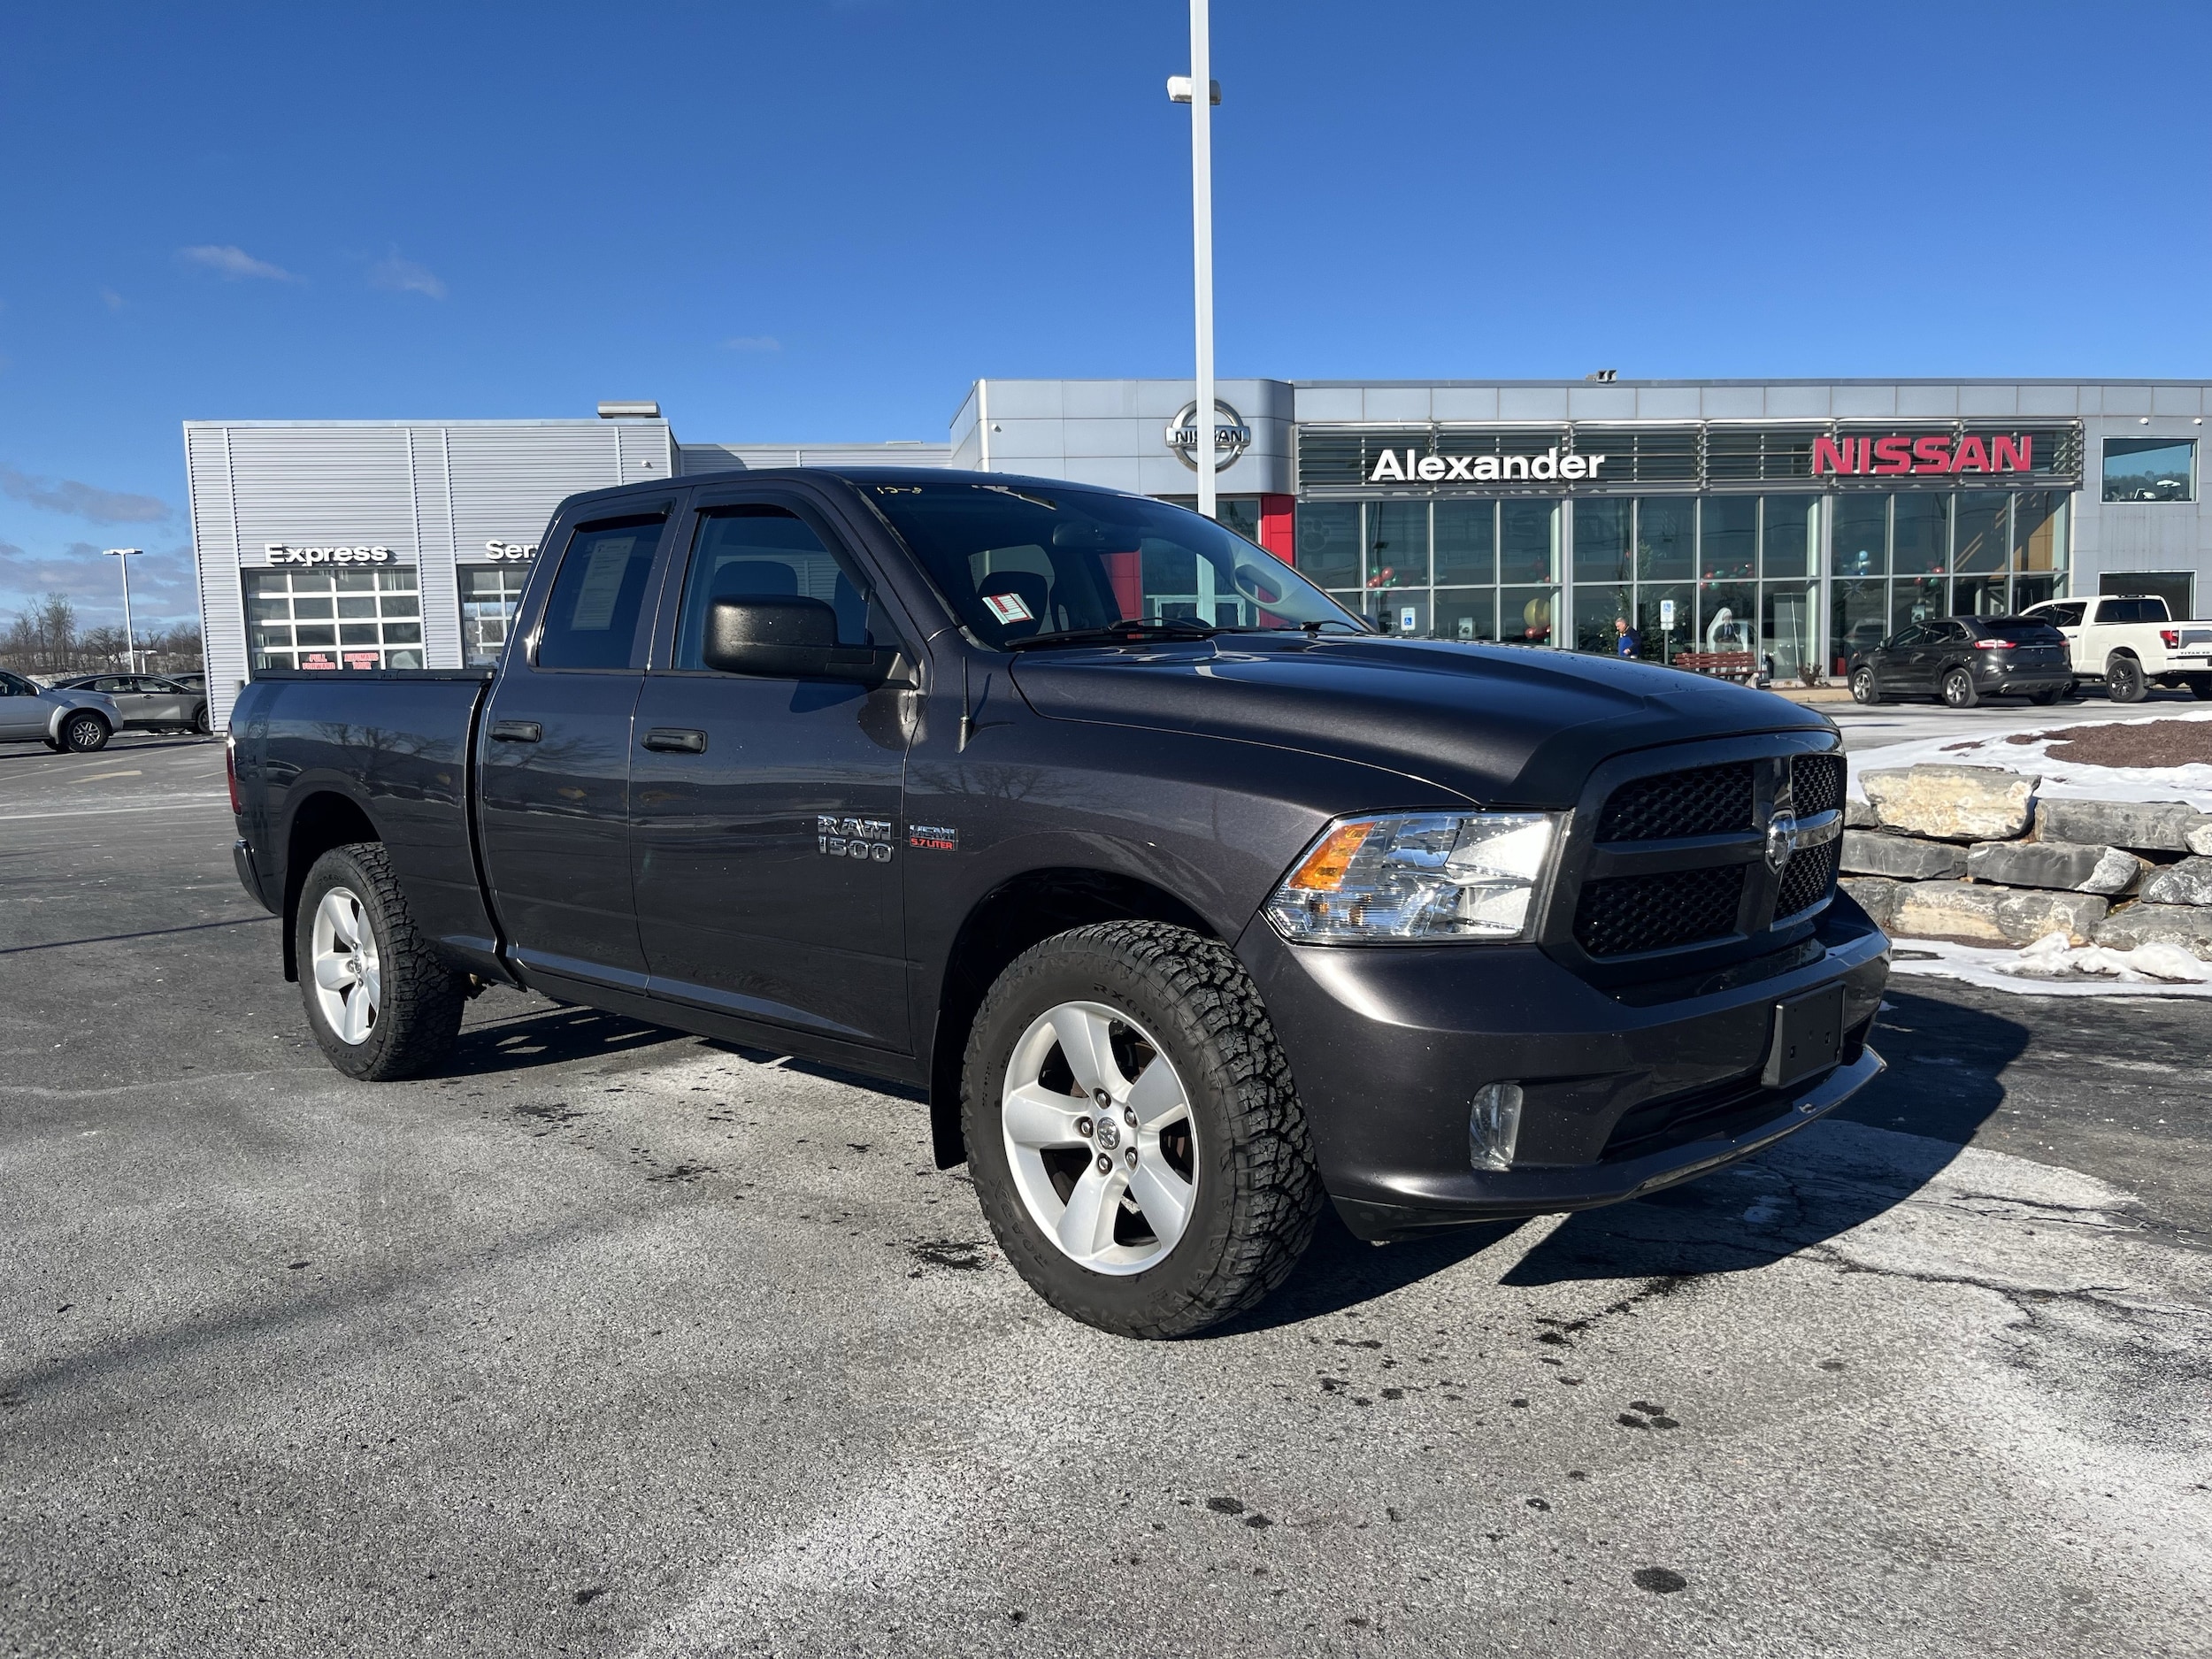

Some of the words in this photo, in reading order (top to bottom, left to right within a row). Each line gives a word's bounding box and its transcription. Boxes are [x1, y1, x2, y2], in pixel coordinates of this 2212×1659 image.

[1175, 430, 1242, 443] NIAN
[1371, 447, 1605, 481] Alexander
[1812, 435, 2032, 475] NISSAN
[264, 543, 388, 567] Express
[309, 653, 327, 663] PULL
[353, 662, 372, 671] DOOR
[818, 814, 892, 841] RAM
[910, 825, 956, 841] HEMI
[818, 834, 894, 863] 1500
[926, 840, 953, 849] LITER
